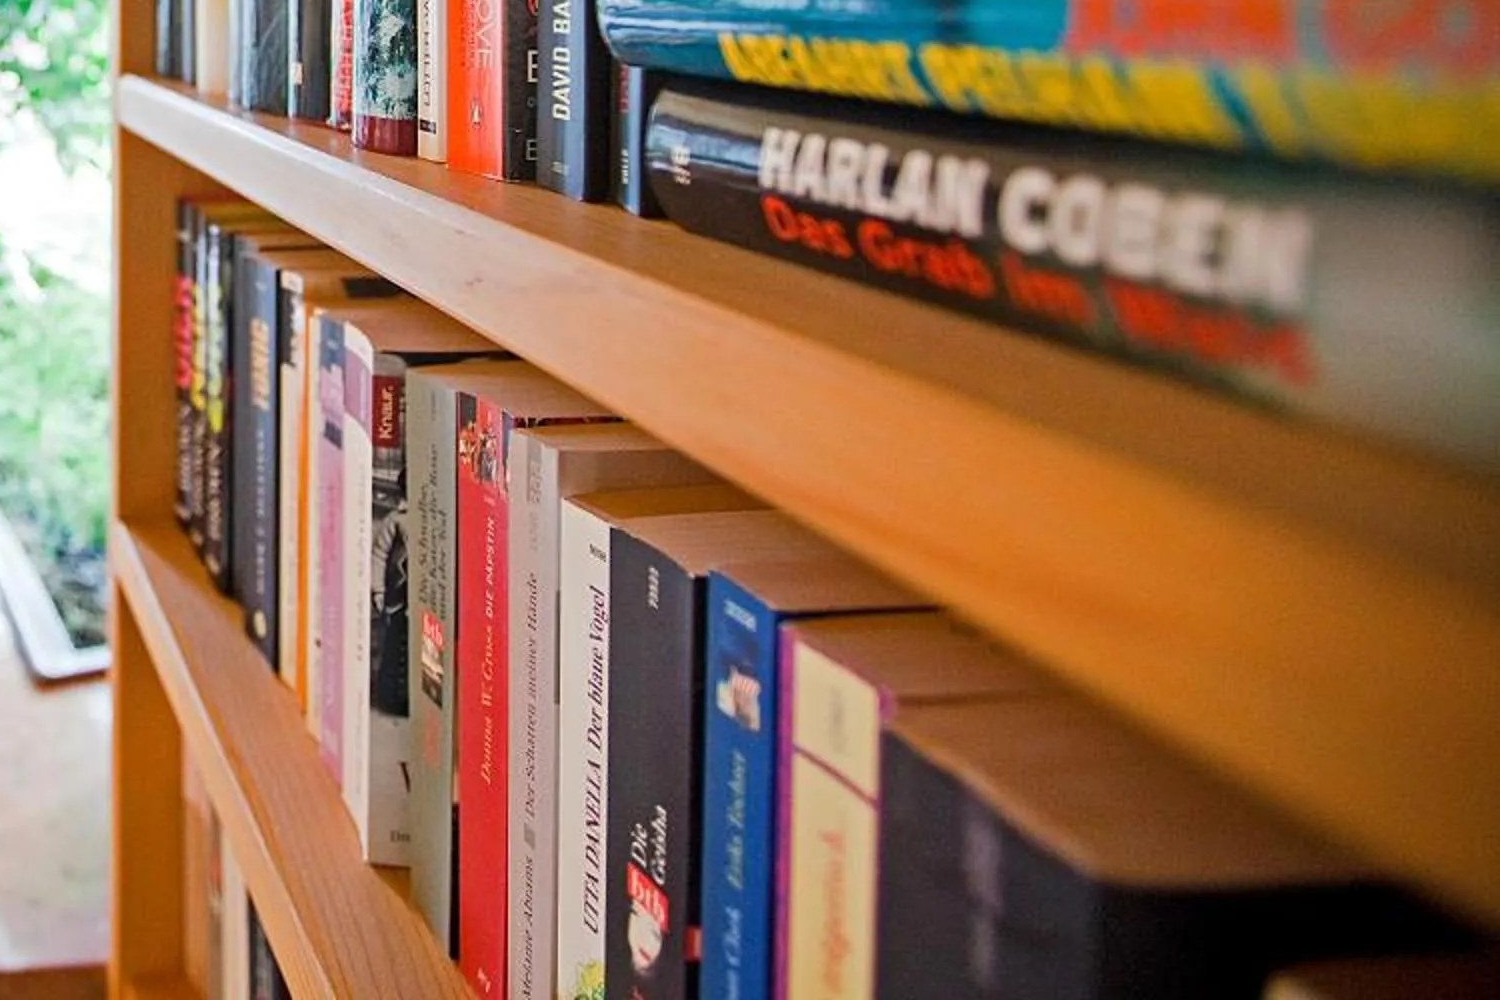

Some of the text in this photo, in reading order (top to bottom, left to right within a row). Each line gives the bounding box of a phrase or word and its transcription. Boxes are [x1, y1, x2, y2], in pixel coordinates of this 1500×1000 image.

[552, 47, 572, 122] DAVID
[758, 125, 1314, 314] HARLAN COBEN
[758, 194, 854, 261] Das
[857, 218, 997, 299] Grab
[481, 625, 494, 681] Cross
[480, 716, 493, 786] Donna
[525, 702, 536, 781] Schatten
[583, 584, 608, 935] UTTA DANELLA Der blaue Vogel
[525, 783, 535, 818] Der
[630, 822, 649, 870] Die
[649, 803, 668, 886] Geisha
[523, 855, 534, 925] Abrams
